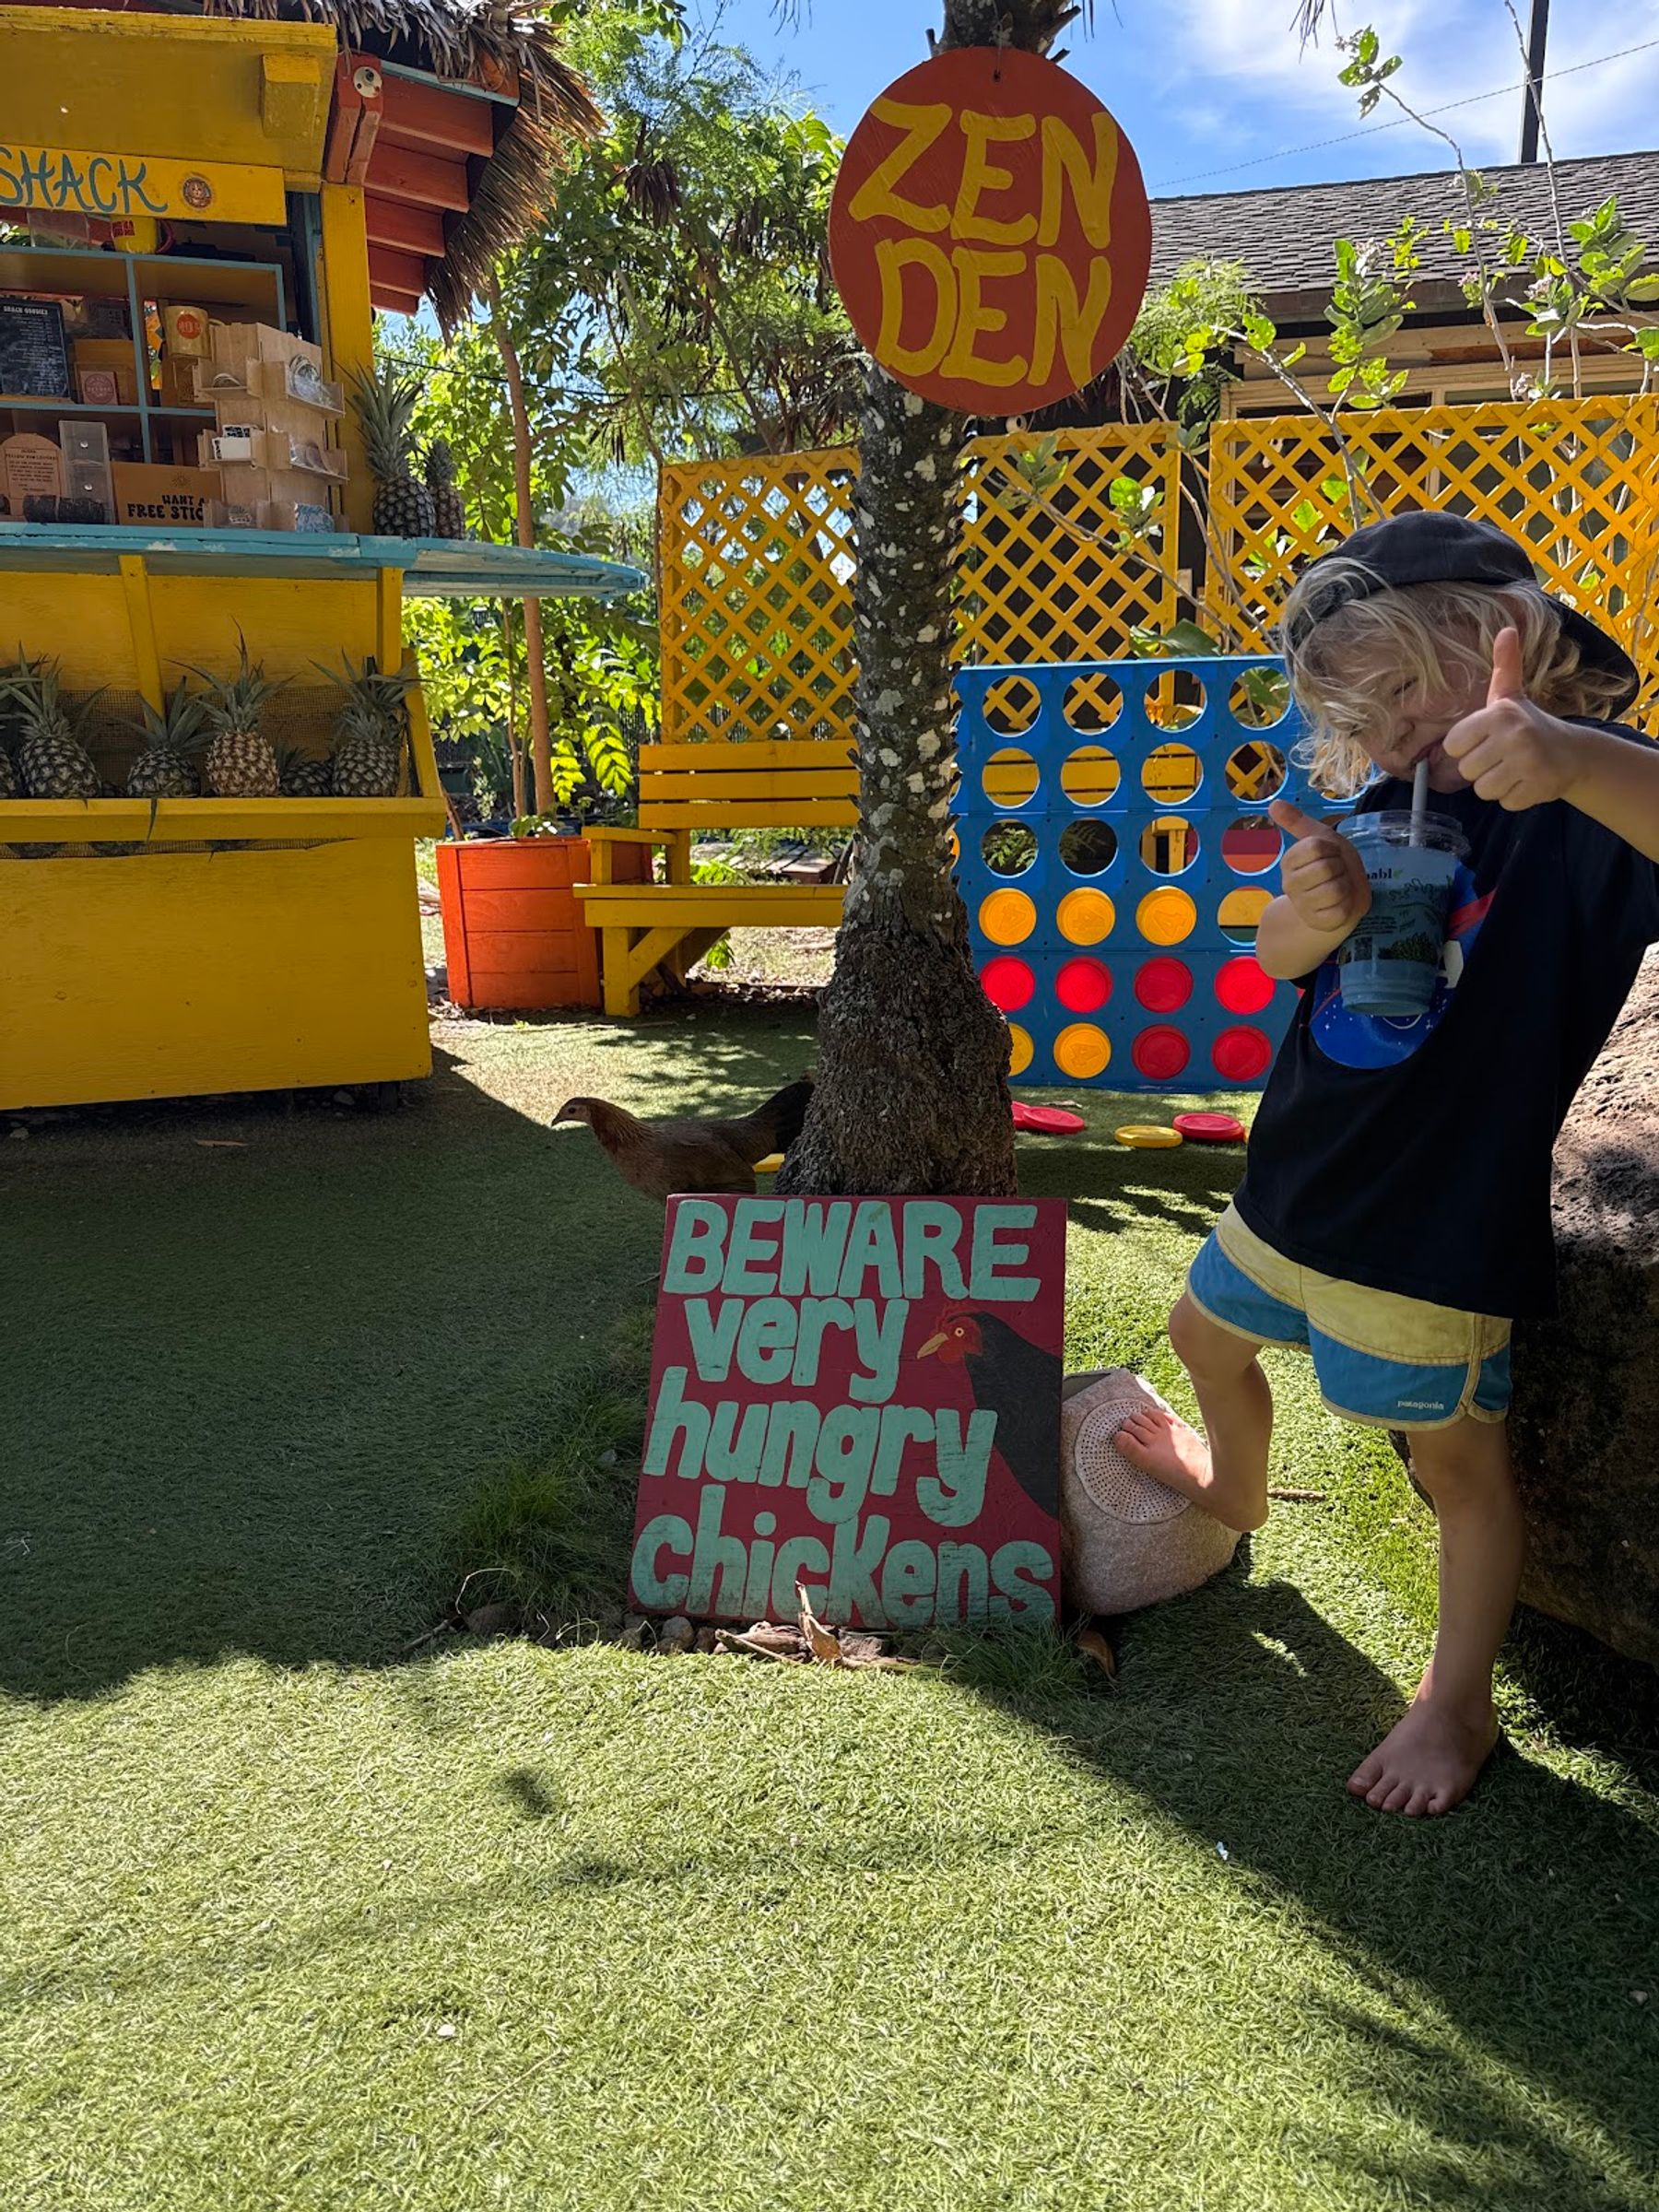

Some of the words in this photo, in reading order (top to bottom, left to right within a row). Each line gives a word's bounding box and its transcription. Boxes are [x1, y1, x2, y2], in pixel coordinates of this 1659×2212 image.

[0, 147, 169, 214] SHACK
[847, 95, 1119, 250] ZEN
[874, 237, 1112, 389] DEN
[127, 503, 166, 519] FREE
[162, 494, 194, 506] WANT
[663, 1198, 1041, 1302] BEWARE
[684, 1297, 910, 1404] very
[642, 1366, 998, 1527] hungry
[1397, 1400, 1444, 1410] patagonia
[630, 1484, 1056, 1630] chickens
